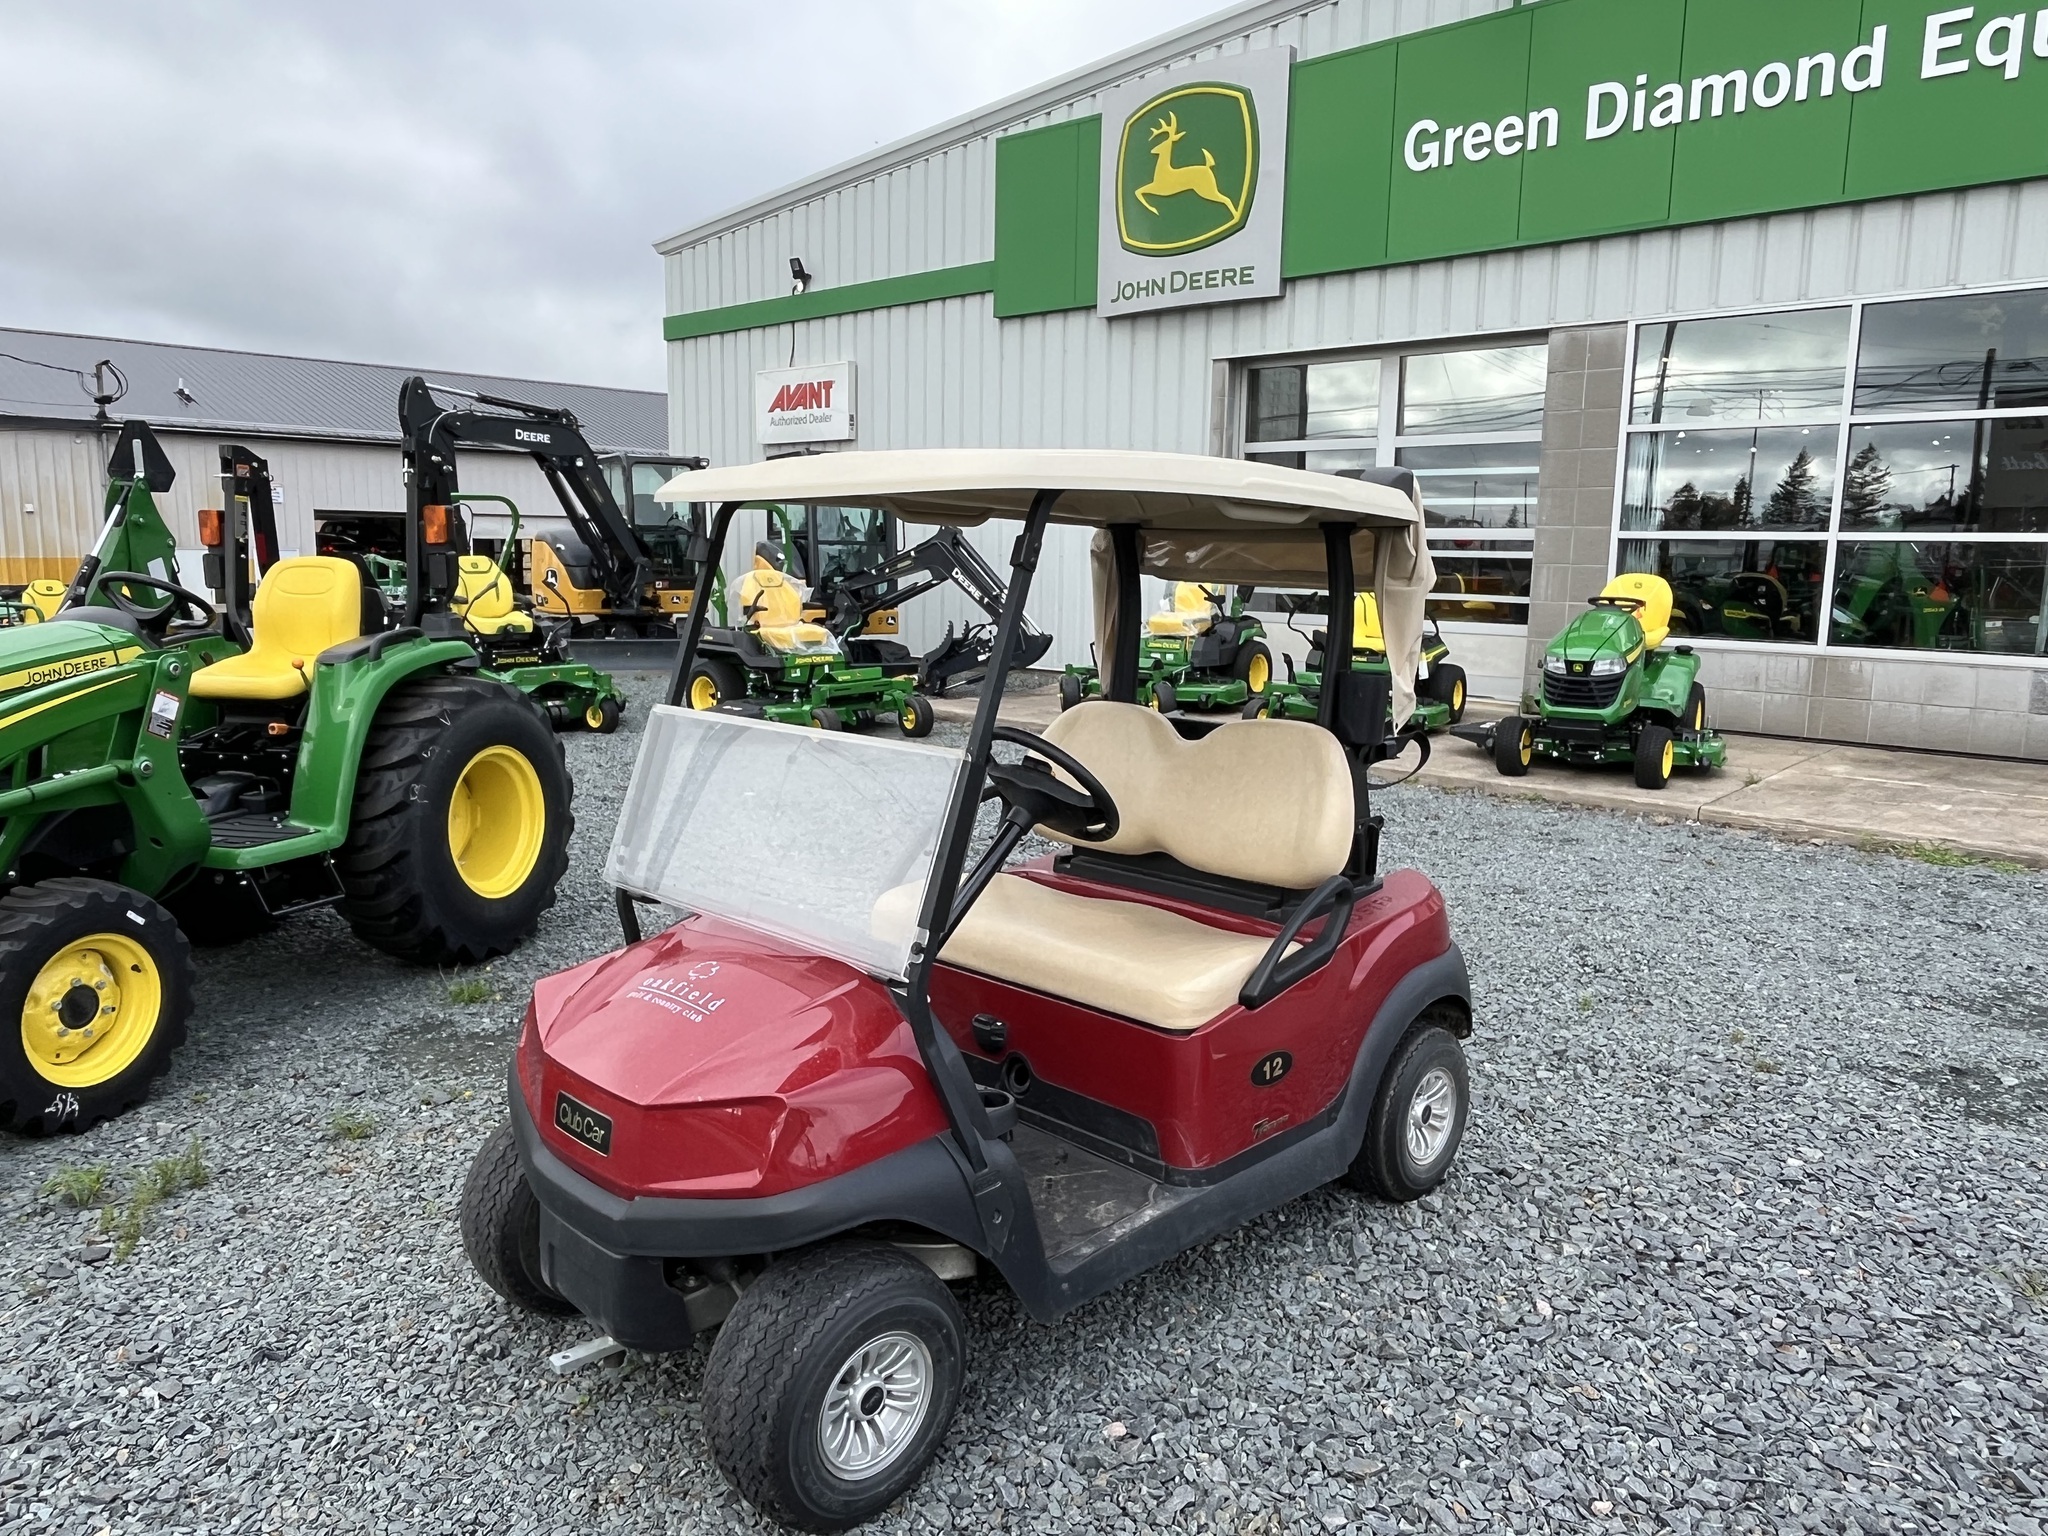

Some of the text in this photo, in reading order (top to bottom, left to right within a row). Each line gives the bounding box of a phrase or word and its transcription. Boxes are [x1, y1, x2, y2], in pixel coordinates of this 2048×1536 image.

[1403, 106, 1559, 172] Green
[1585, 24, 1887, 141] Diamond
[1110, 266, 1255, 303] JOHN DEERE
[768, 380, 833, 413] AVANT
[515, 428, 551, 444] DEERE
[770, 412, 832, 427] Authorized Dealer
[951, 567, 982, 600] DEERE
[24, 657, 107, 686] JOHN DEERE
[643, 978, 725, 1011] oakfield
[652, 997, 682, 1014] country
[682, 1009, 703, 1023] club
[1263, 1057, 1283, 1080] 12
[560, 1103, 605, 1144] Club Car
